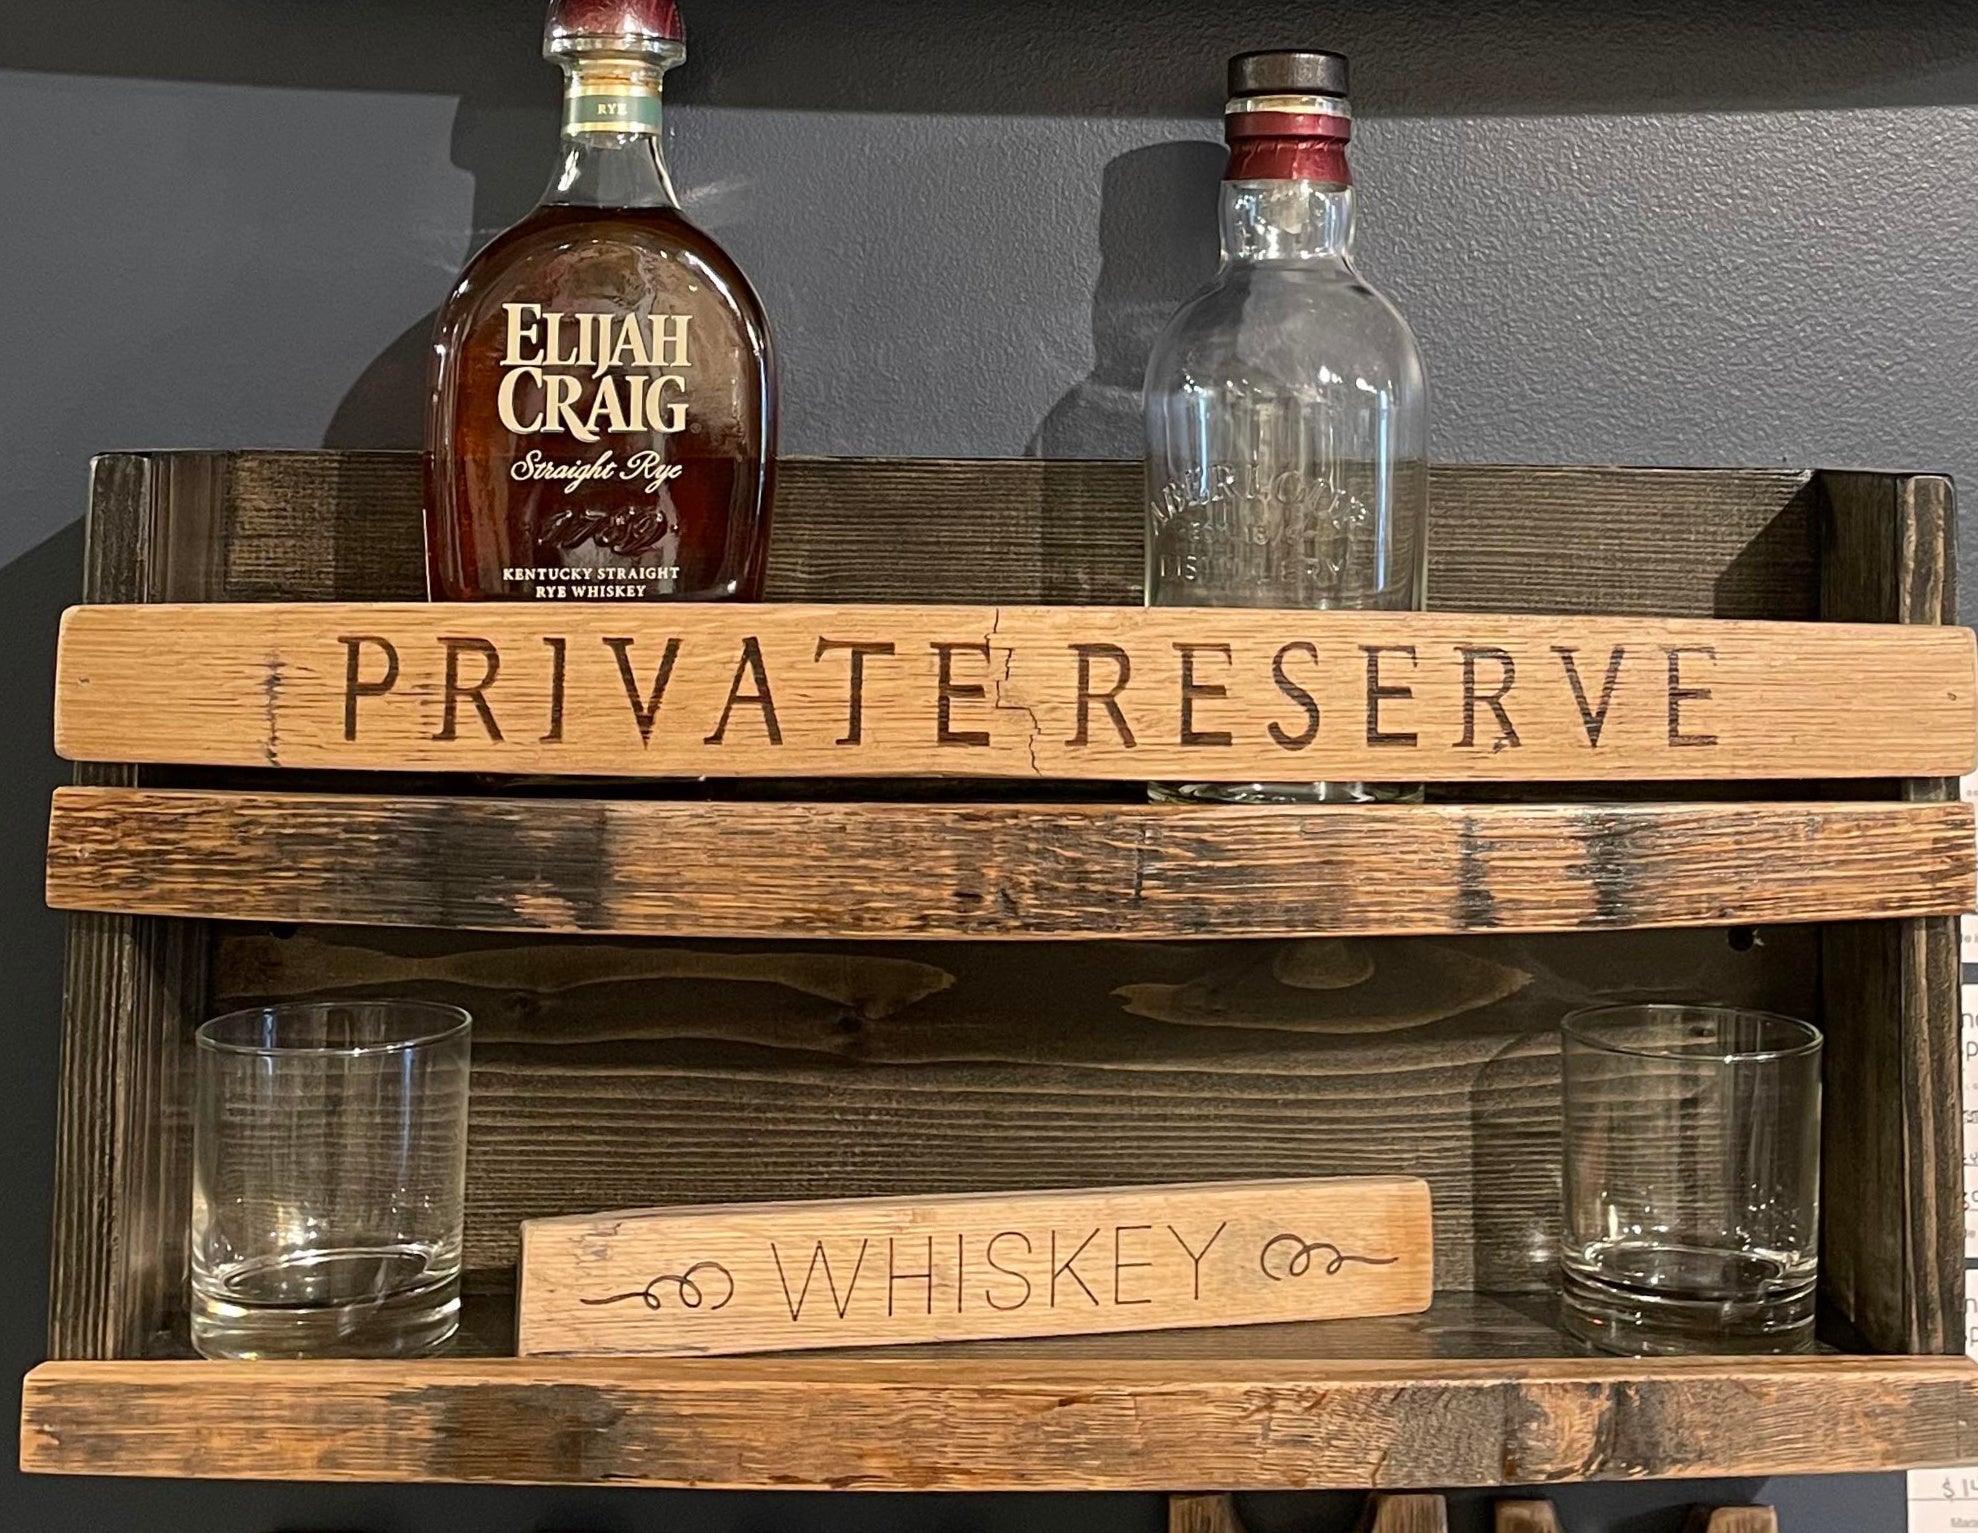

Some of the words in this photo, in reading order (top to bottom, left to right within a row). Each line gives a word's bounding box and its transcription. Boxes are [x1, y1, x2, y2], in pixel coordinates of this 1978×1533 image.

[597, 103, 627, 116] RYE
[500, 302, 692, 378] ELIJAH
[497, 366, 690, 442] CRAIG
[510, 449, 617, 494] Straight
[621, 449, 683, 493] Rye
[502, 567, 592, 581] KENTUCKY
[596, 566, 681, 580] STRAIGHT
[535, 586, 567, 599] RYE
[571, 584, 647, 598] WHISKEY
[336, 635, 992, 749] PRIVATE
[1064, 640, 1720, 754] RESERVE
[770, 1221, 1227, 1322] WHISKEY
